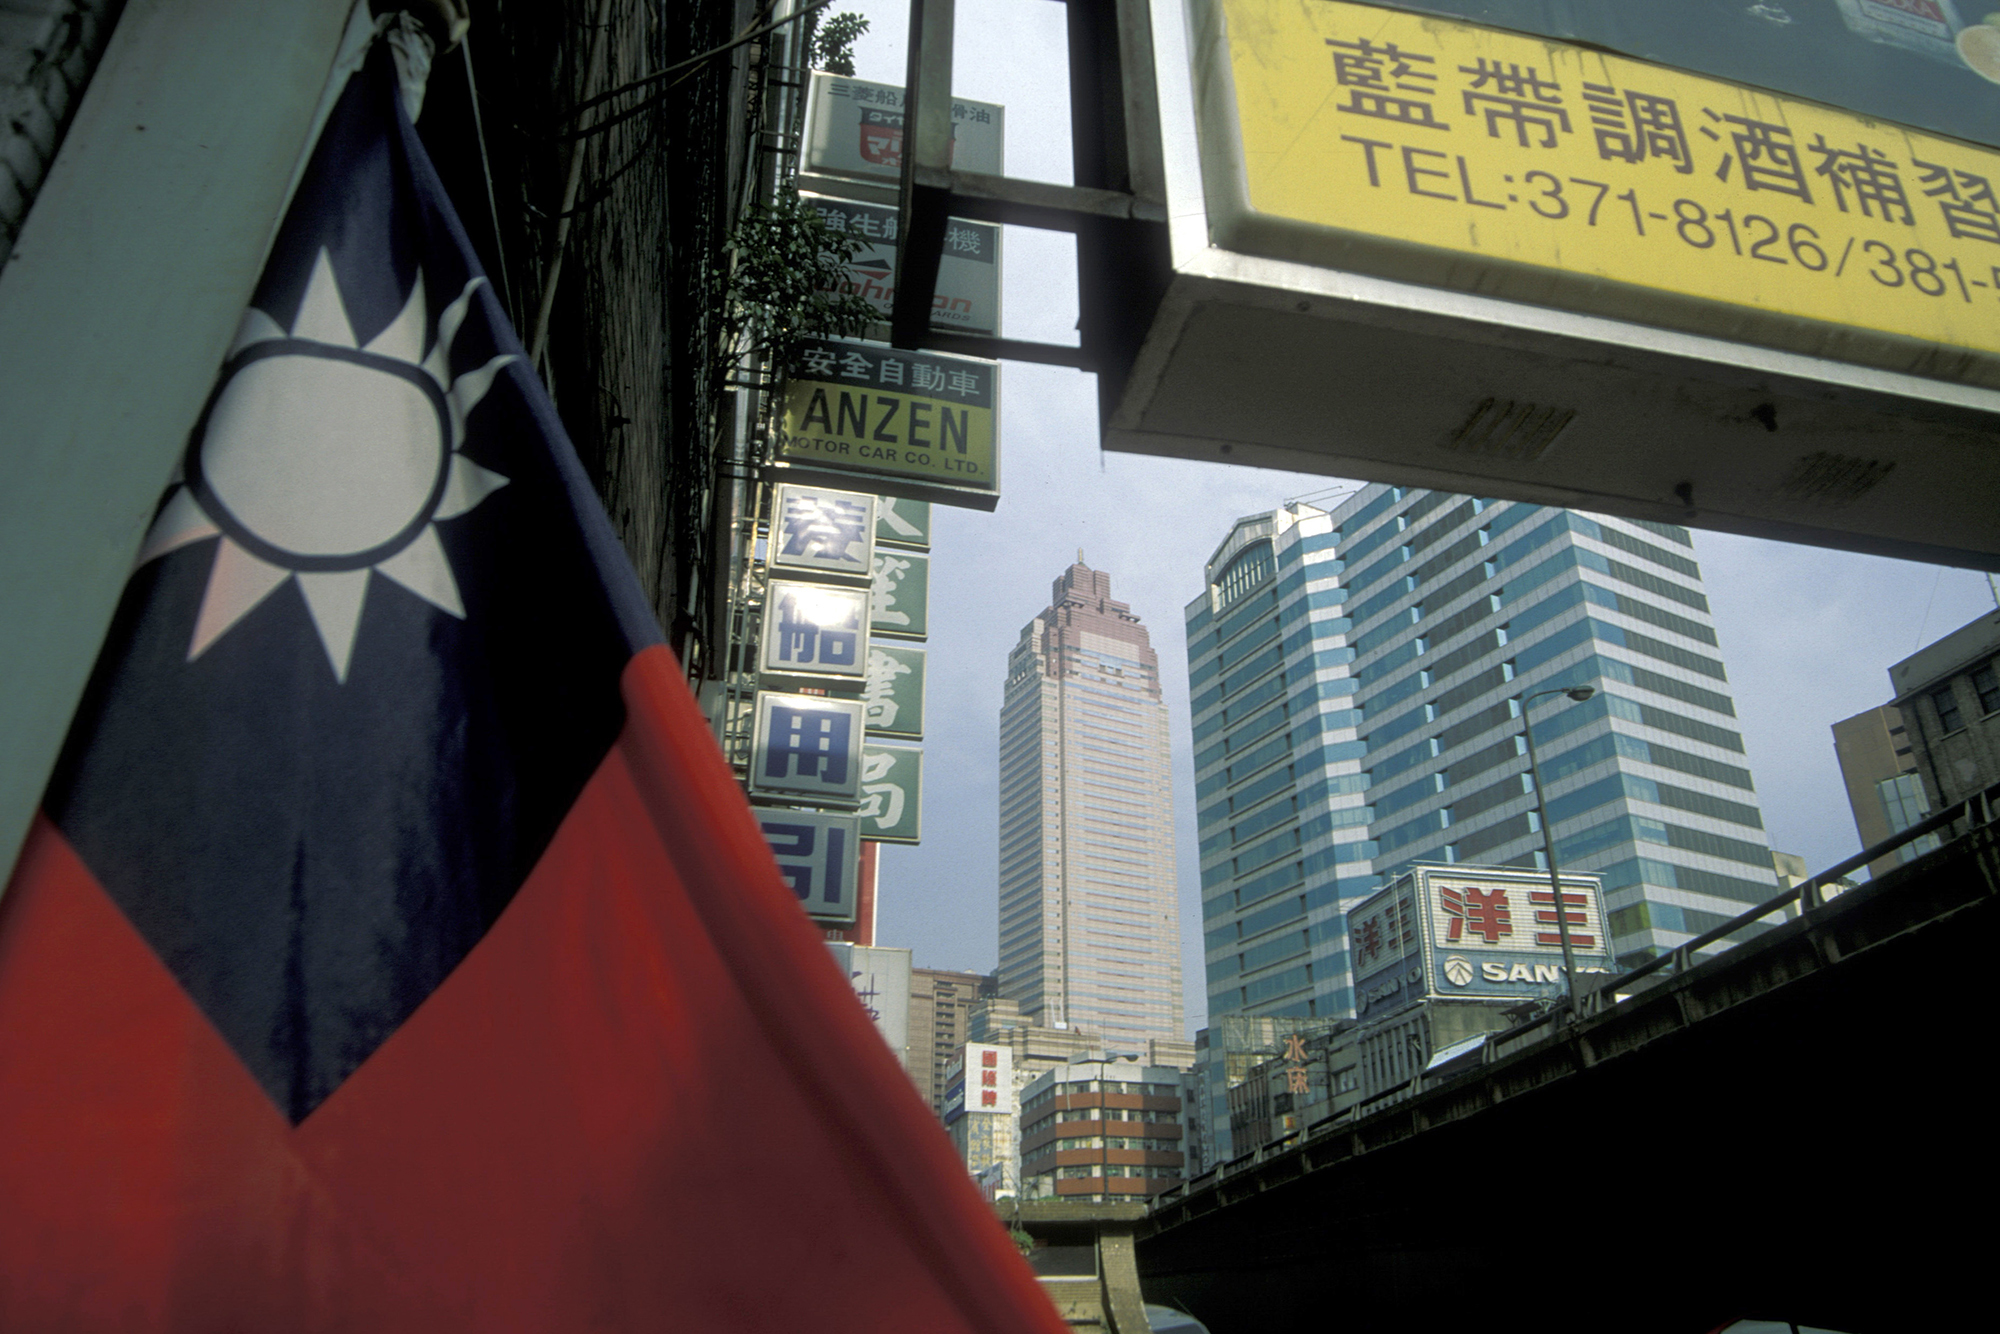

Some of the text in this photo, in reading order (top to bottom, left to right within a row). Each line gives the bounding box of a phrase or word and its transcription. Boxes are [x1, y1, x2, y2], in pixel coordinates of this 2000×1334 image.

[1339, 134, 2000, 304] TEL:371-8126/381-
[801, 347, 981, 397] 安全自動車
[800, 387, 970, 455] ANZEN
[783, 436, 985, 476] MOTOR CAR CO. LTD.
